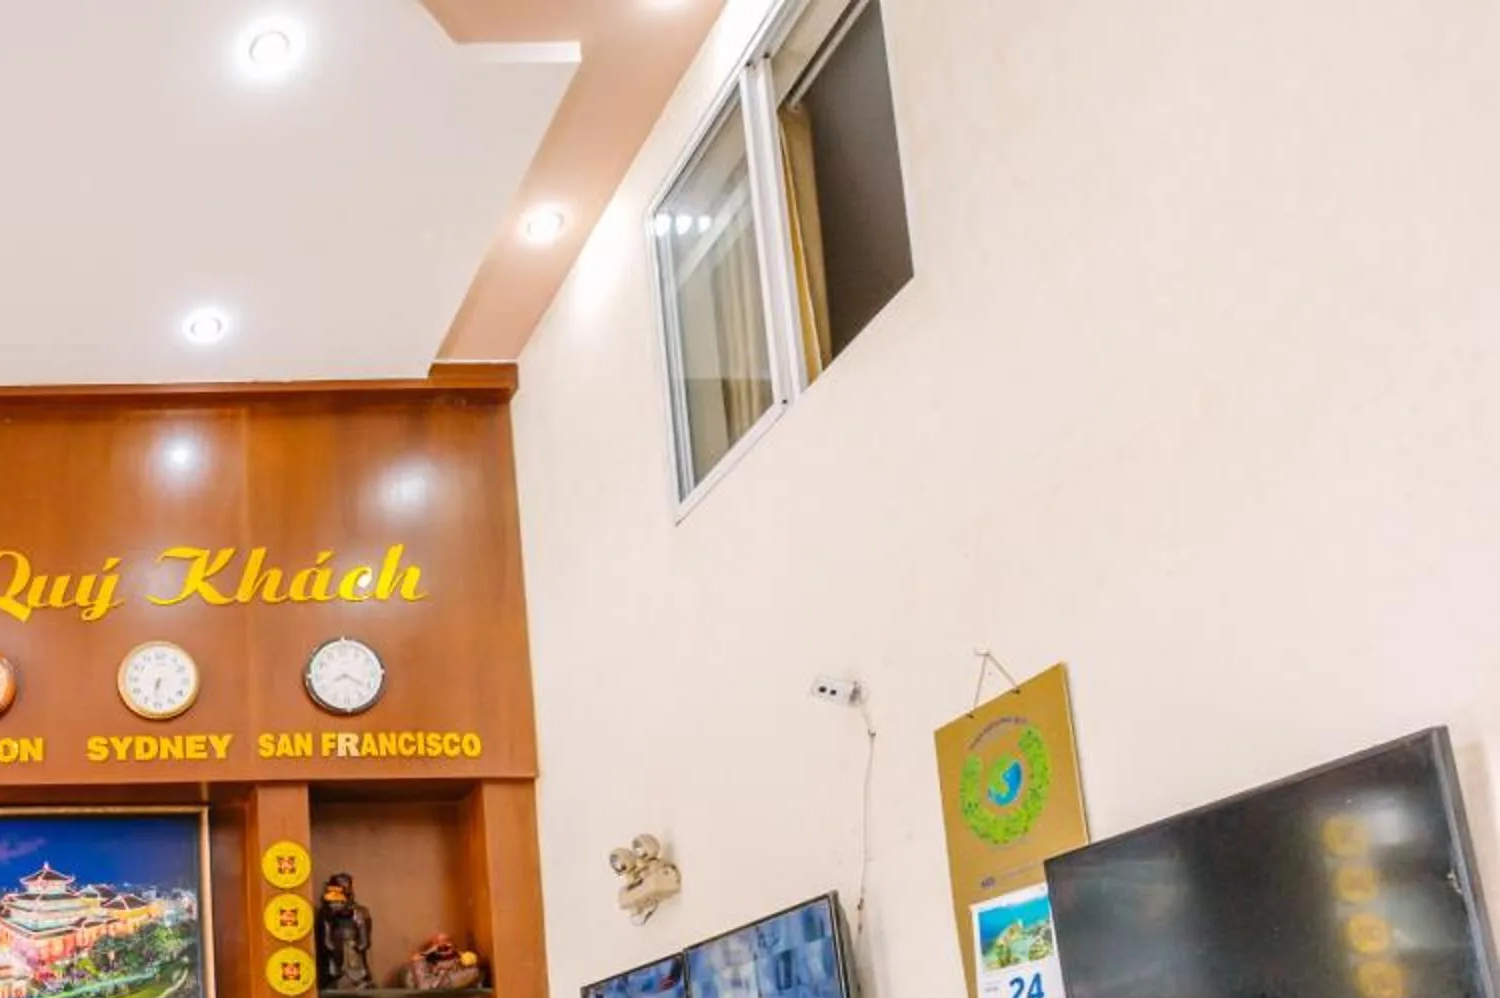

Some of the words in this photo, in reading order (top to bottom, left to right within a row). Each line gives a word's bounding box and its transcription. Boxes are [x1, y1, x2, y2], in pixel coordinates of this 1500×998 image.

[145, 543, 429, 607] Khách
[87, 734, 233, 761] SYDNEY
[258, 733, 313, 757] SAN
[321, 732, 483, 758] FRANCISCO
